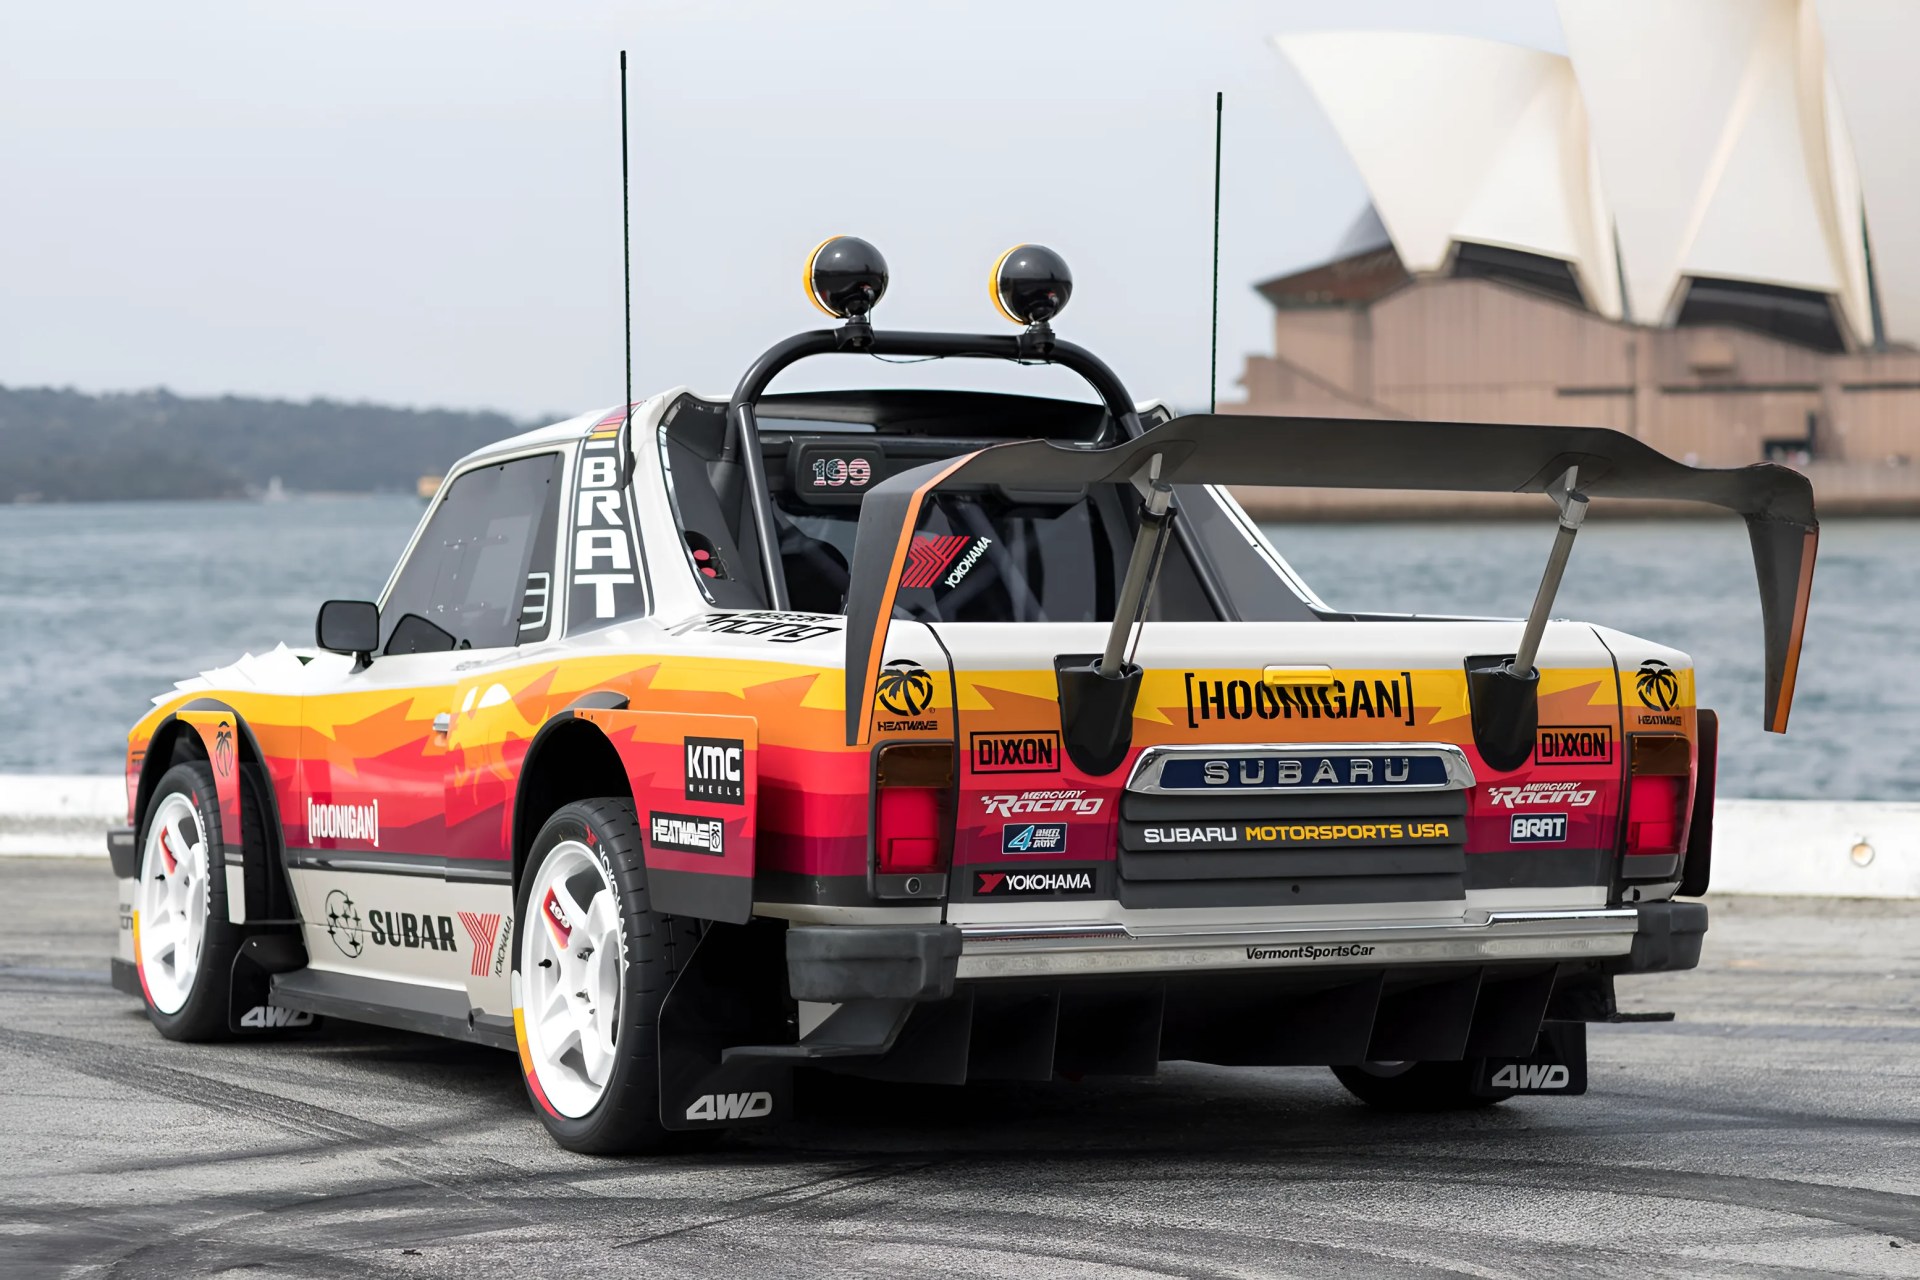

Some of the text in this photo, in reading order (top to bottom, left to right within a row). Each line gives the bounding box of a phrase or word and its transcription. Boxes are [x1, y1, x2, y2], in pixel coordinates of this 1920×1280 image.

[813, 458, 871, 486] 199
[574, 456, 635, 619] BRAT
[944, 536, 992, 588] YOKOHAMA
[877, 720, 938, 732] HEATWAVE
[978, 738, 1053, 766] DIXXON
[1541, 732, 1606, 758] DIXXON
[687, 744, 741, 782] KMC
[1203, 757, 1410, 785] SUBARU
[688, 783, 741, 797] WHEELS
[1020, 790, 1087, 800] MERCURY
[1488, 786, 1597, 809] Racing
[1519, 782, 1581, 792] MERCURY
[981, 795, 1104, 817] Racing
[307, 796, 379, 847] [HOONIGAN]
[1143, 822, 1449, 843] SUBARU MOTORSPORTS USA
[1513, 817, 1565, 838] BRAT
[1006, 873, 1091, 890] YOKOHAMA
[1246, 944, 1375, 960] VermontSportsCar
[240, 1006, 314, 1028] 4WD
[1491, 1064, 1570, 1089] 4WD
[686, 1091, 773, 1121] 4WD
